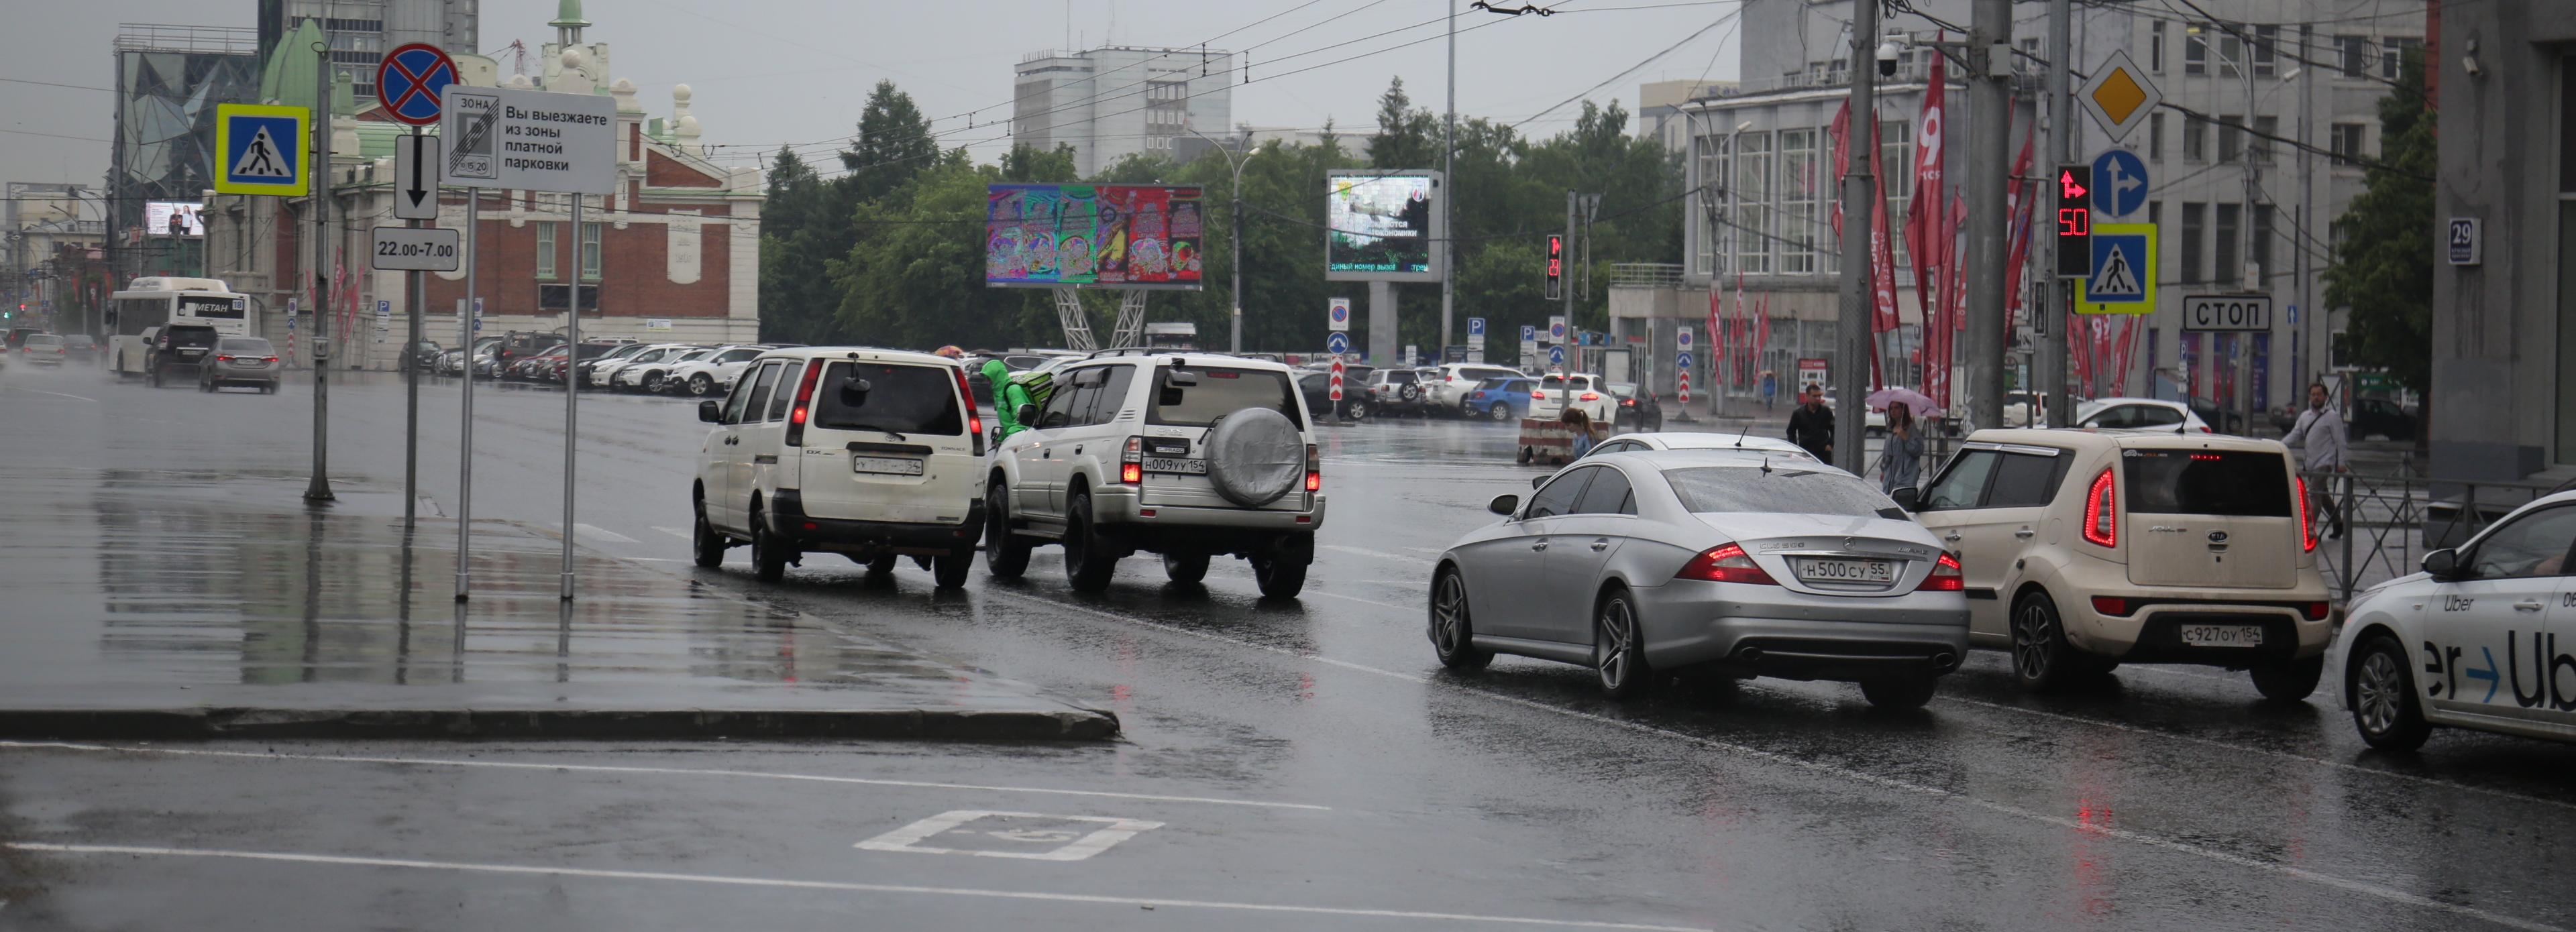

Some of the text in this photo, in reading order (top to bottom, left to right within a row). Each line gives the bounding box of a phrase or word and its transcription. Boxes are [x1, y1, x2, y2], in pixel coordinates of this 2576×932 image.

[461, 98, 489, 109] ЗОНА
[506, 106, 607, 125] Вы выезжаете
[505, 125, 560, 137] из зоны
[1920, 106, 1941, 167] 9
[505, 141, 562, 154] платной
[476, 162, 486, 171] 20
[505, 158, 569, 171] парковки
[2059, 208, 2088, 236] 50
[2452, 223, 2472, 244] 29
[378, 241, 453, 257] 22.00-7.00
[196, 303, 229, 312] МЕТАН
[2196, 302, 2259, 326] СТОП
[1188, 460, 1205, 469] 154
[1870, 563, 1885, 575] 55
[2444, 595, 2474, 612] Uber
[2241, 627, 2261, 639] 154
